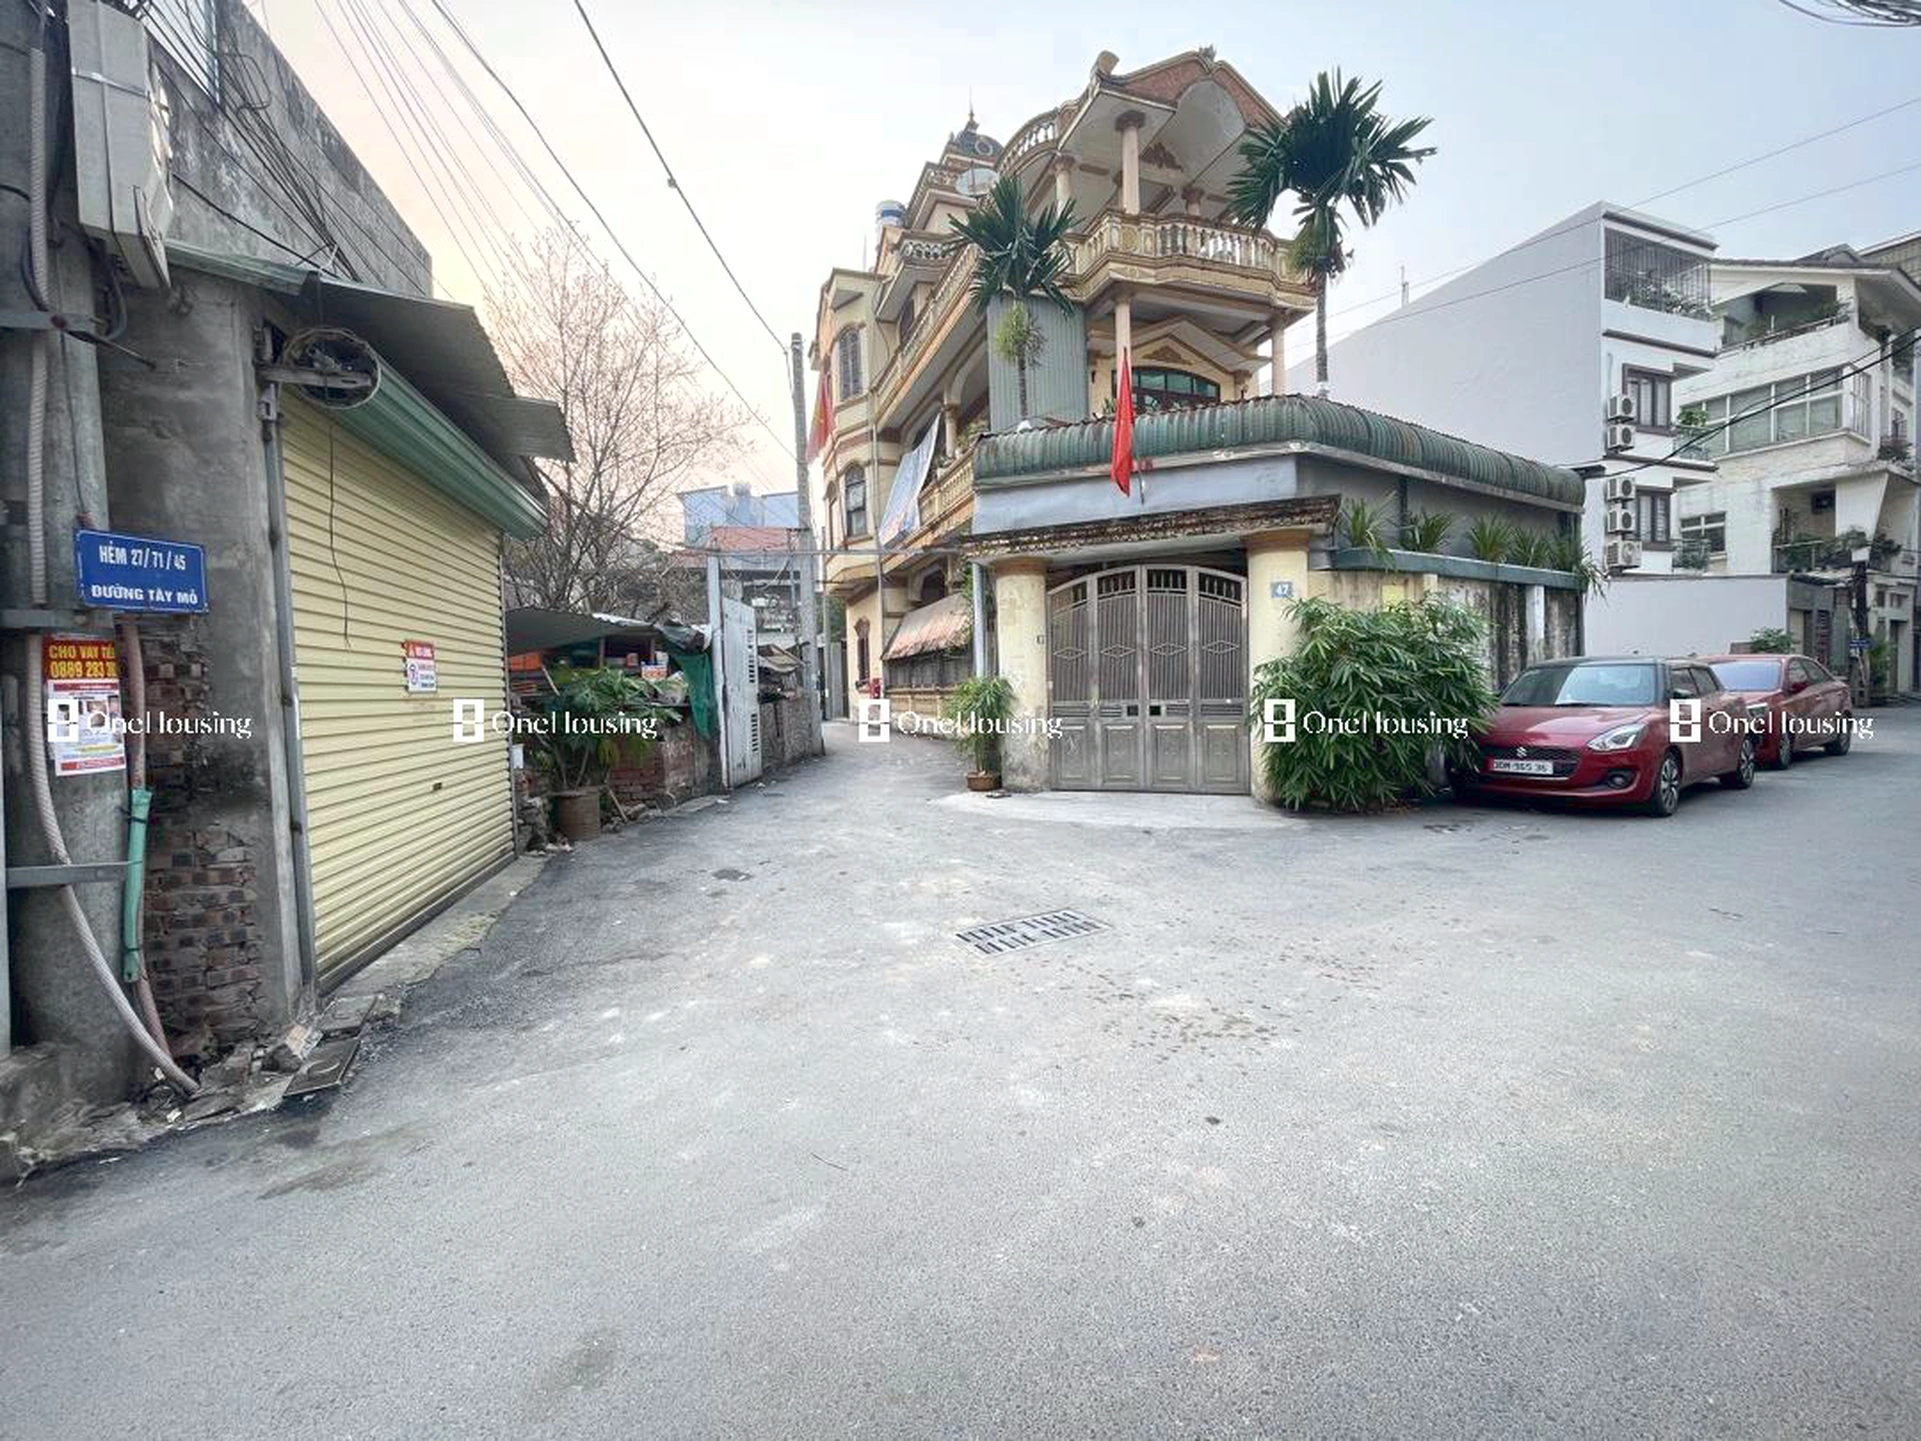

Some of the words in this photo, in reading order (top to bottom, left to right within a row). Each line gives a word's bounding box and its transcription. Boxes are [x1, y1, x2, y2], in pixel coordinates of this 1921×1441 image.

[91, 583, 144, 601] ĐƯỜNG
[148, 587, 173, 603] TÂY
[49, 645, 76, 659] CHO
[79, 645, 99, 659] VAY
